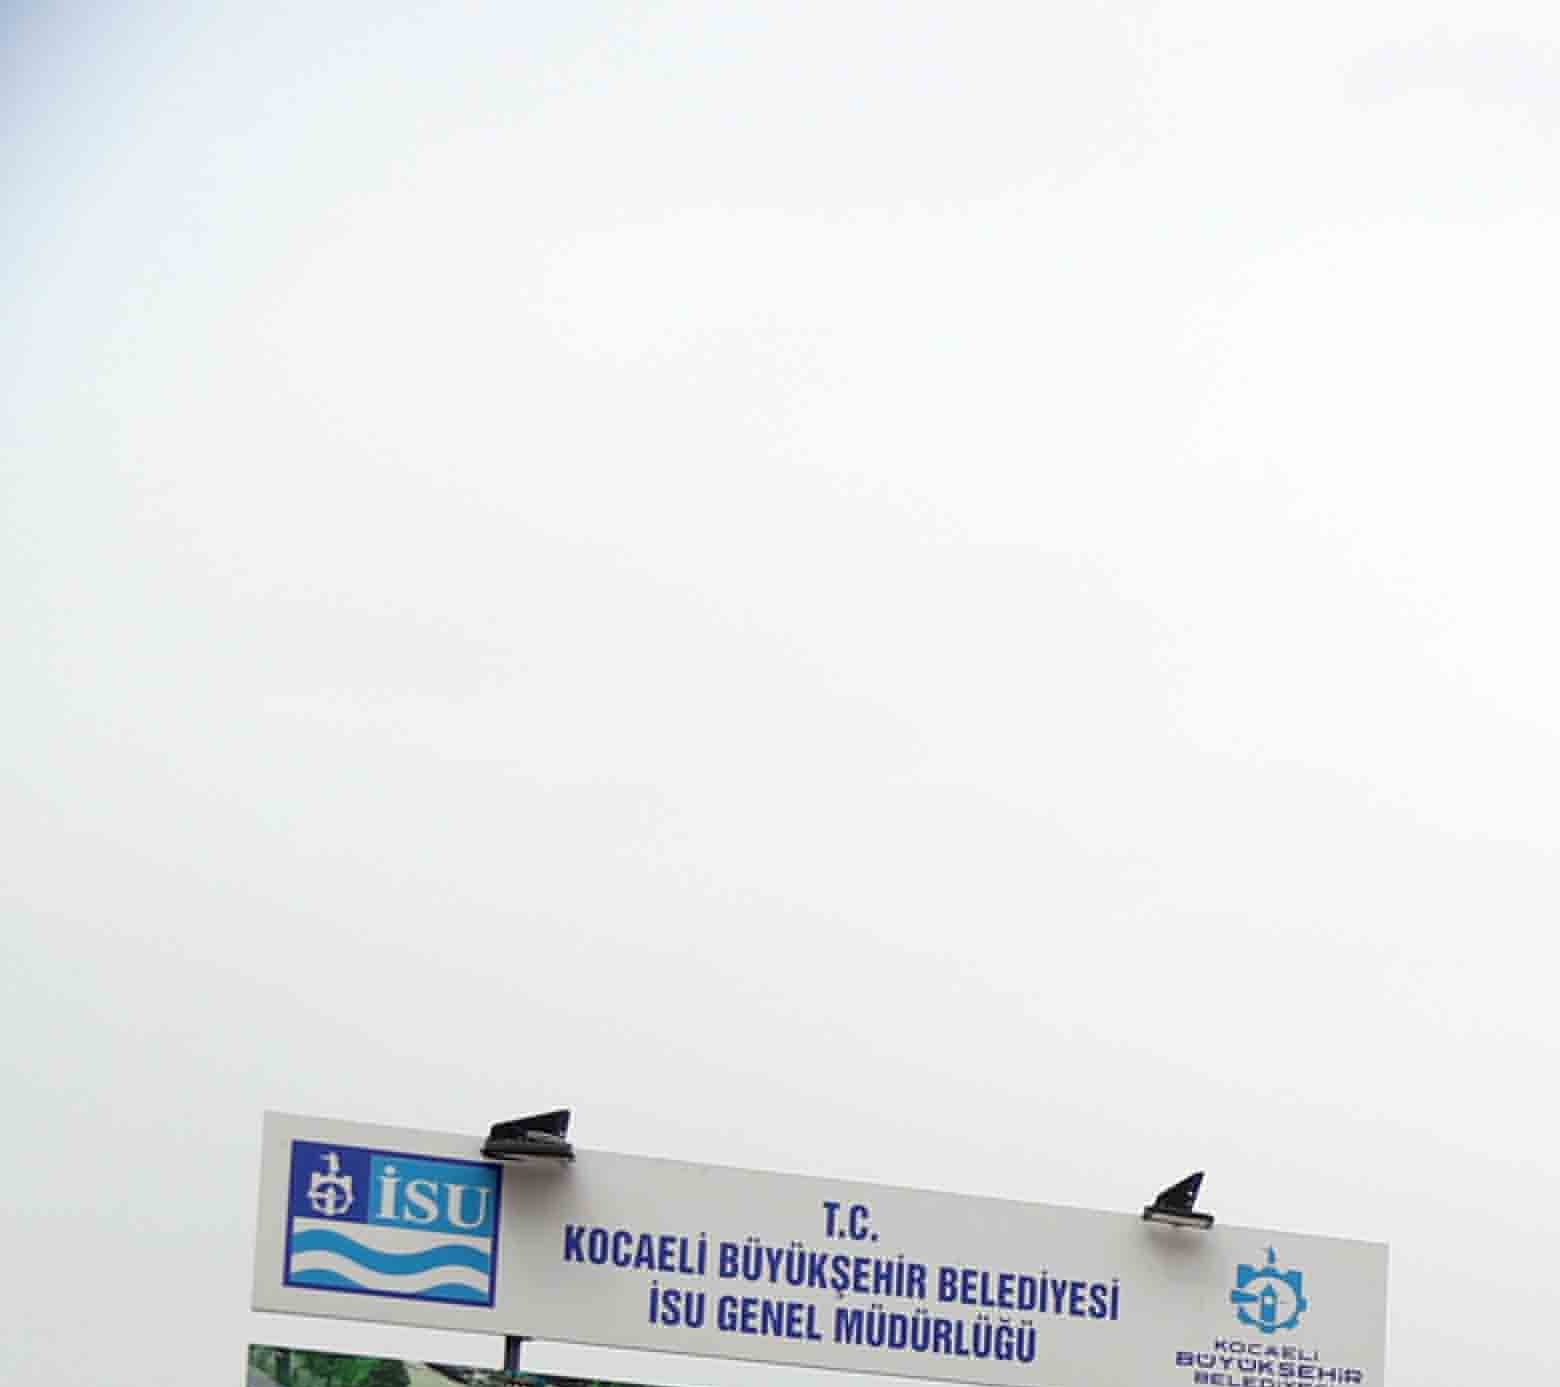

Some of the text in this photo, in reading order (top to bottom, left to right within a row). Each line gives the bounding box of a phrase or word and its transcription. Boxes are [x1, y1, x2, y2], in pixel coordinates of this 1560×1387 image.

[376, 1165, 491, 1231] İSU
[823, 1202, 880, 1242] T.C.
[564, 1225, 1120, 1320] KOCAELİ BÜYÜKŞEHİR BELEDİYESİ
[648, 1280, 1038, 1363] İSU GENEL MÜDÜRLÜĞÜ
